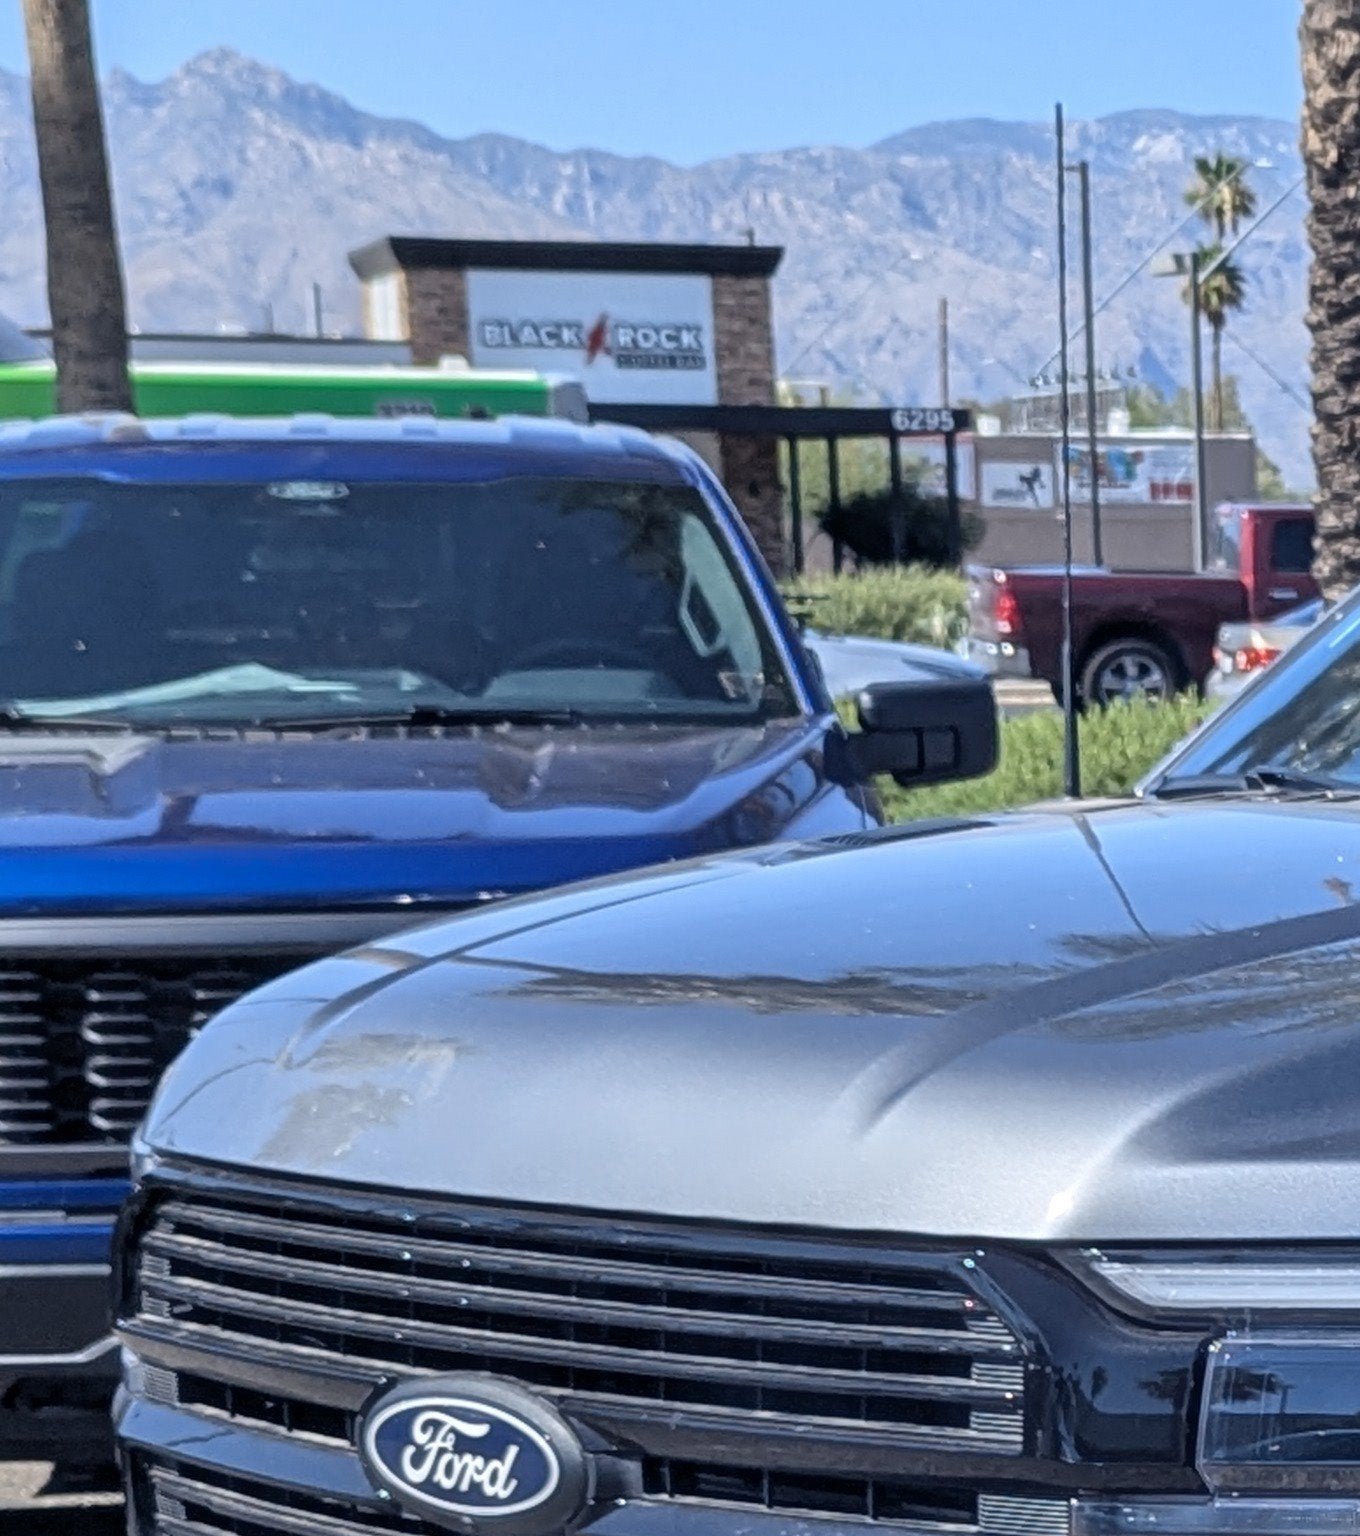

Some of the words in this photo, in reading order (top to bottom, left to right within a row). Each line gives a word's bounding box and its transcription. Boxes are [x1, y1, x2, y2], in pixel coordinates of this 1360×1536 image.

[481, 322, 582, 347] BLACK
[616, 325, 703, 350] ROCK
[891, 409, 954, 432] 6295
[402, 1410, 521, 1499] Ford
